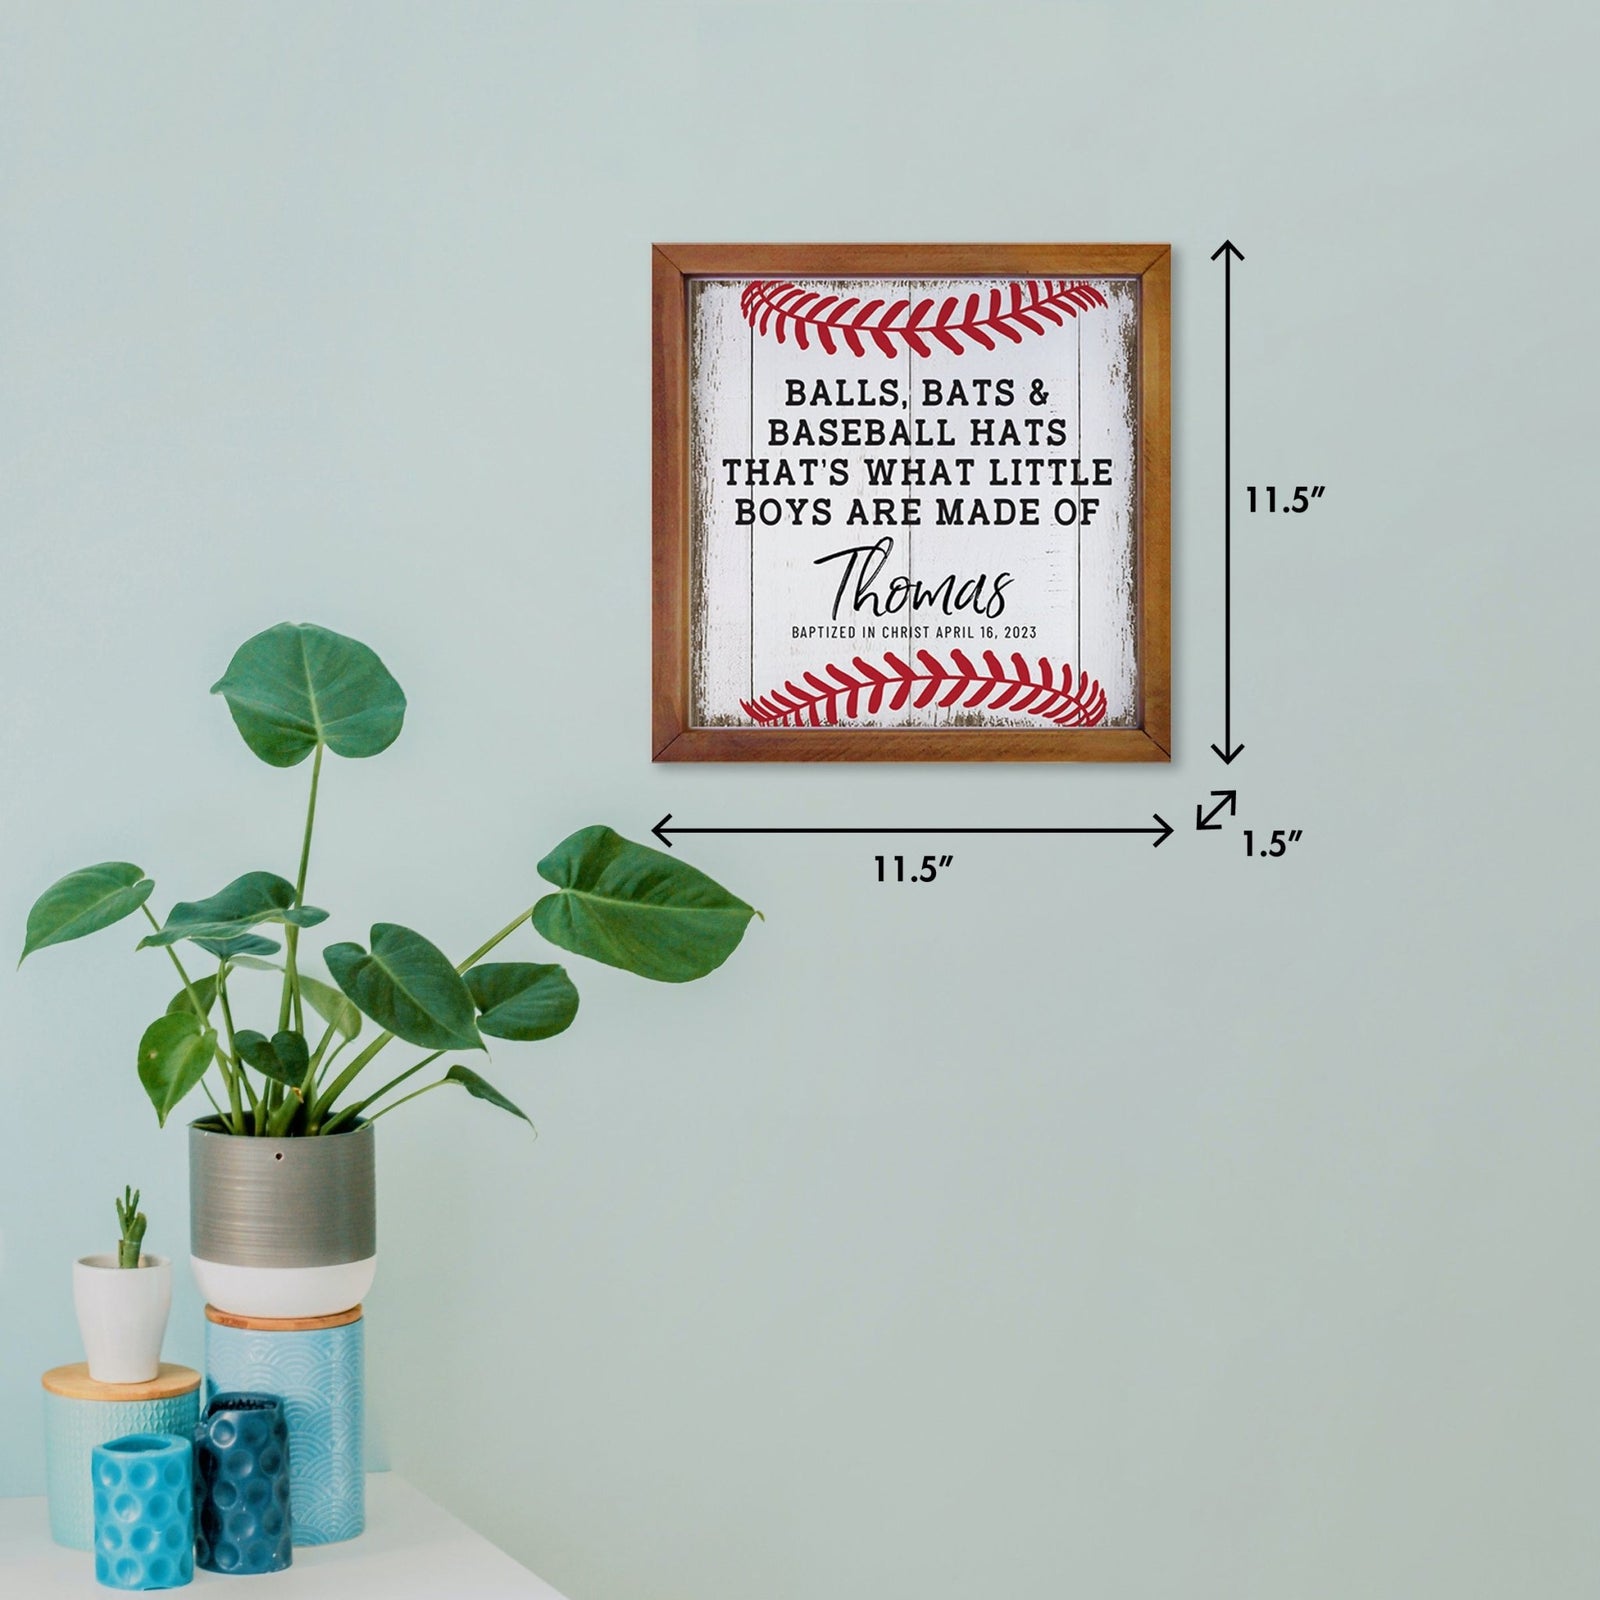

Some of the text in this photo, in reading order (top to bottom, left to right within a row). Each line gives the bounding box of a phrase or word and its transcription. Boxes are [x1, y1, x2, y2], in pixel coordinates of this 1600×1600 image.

[785, 379, 1049, 410] BALLS, BATS &
[767, 419, 1066, 446] BASEBALL HATS
[723, 459, 1112, 486] THAT'S WHAT LITTLE
[736, 498, 1099, 526] BOYS ARE MADE OF
[813, 536, 1015, 621] Thomas
[793, 626, 1036, 639] BAPTIZED IN CHRIST APRIL 16, 2023
